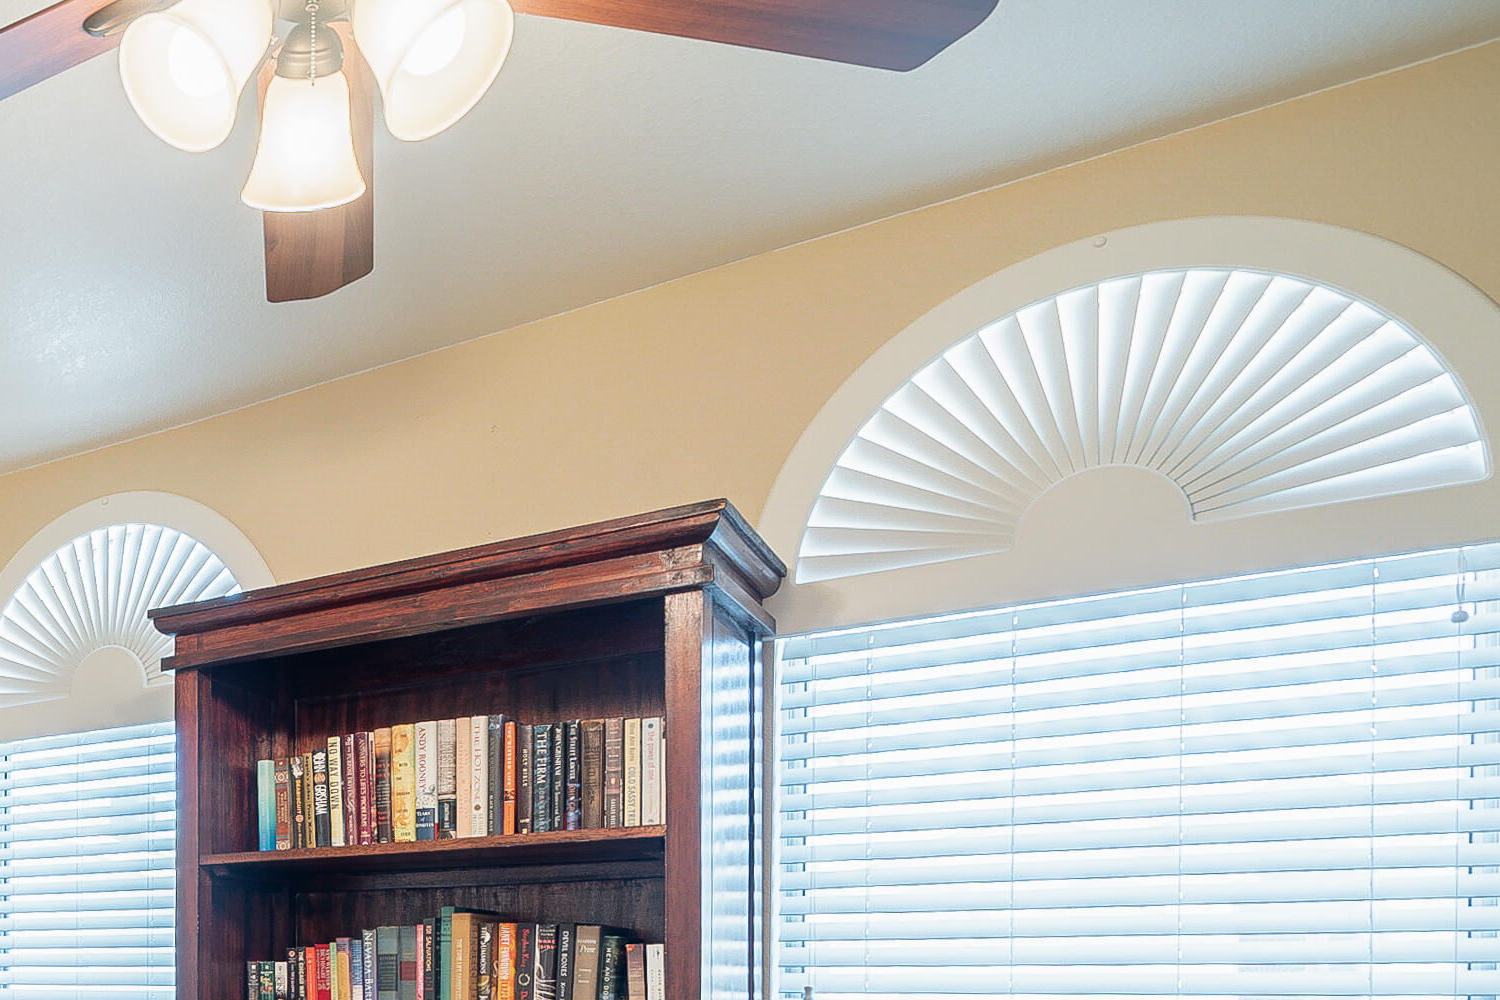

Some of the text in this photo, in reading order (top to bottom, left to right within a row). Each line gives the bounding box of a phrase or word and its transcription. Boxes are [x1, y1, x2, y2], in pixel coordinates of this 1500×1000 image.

[360, 768, 366, 778] TO
[418, 727, 427, 789] ANDY ROONEY
[474, 748, 482, 771] HOT
[537, 732, 547, 784] THE FIRM
[329, 742, 340, 810] NO WAY DOWN
[628, 767, 636, 784] COLD
[628, 785, 636, 807] SASSY
[501, 926, 510, 945] JANET
[364, 932, 373, 974] NEVADA
[500, 947, 510, 979] EVANOVICH
[560, 931, 569, 976] DEVIL BONES
